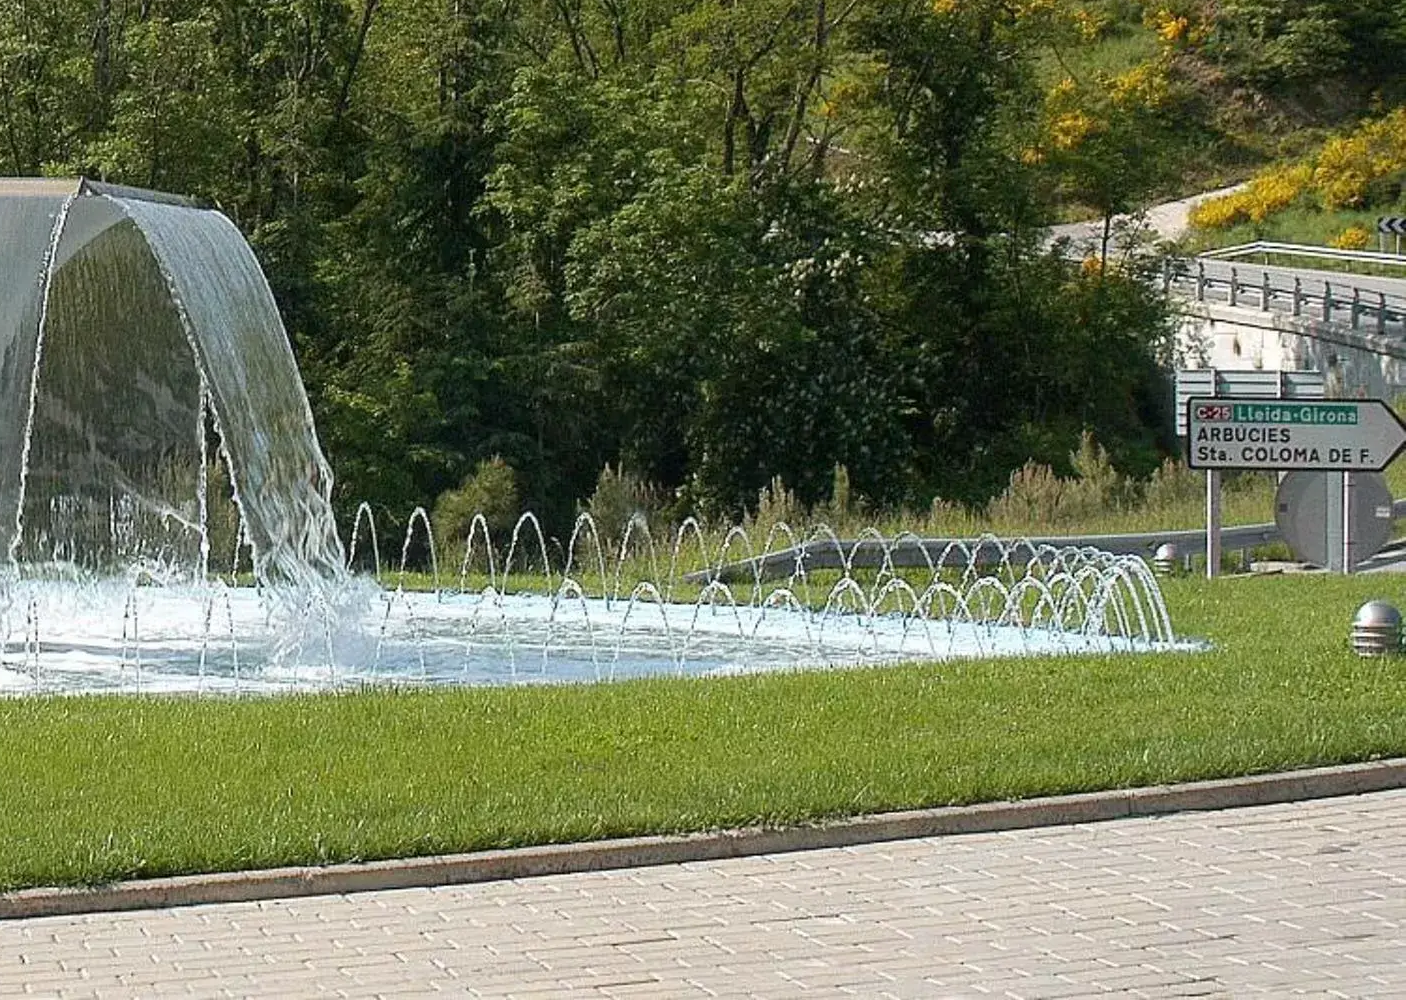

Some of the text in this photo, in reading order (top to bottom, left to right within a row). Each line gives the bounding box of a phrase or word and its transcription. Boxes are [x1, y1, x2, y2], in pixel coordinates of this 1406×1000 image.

[1196, 406, 1357, 423] C-25 Lleida-Girona
[1197, 447, 1374, 464] Sta. COLOMA DE F.
